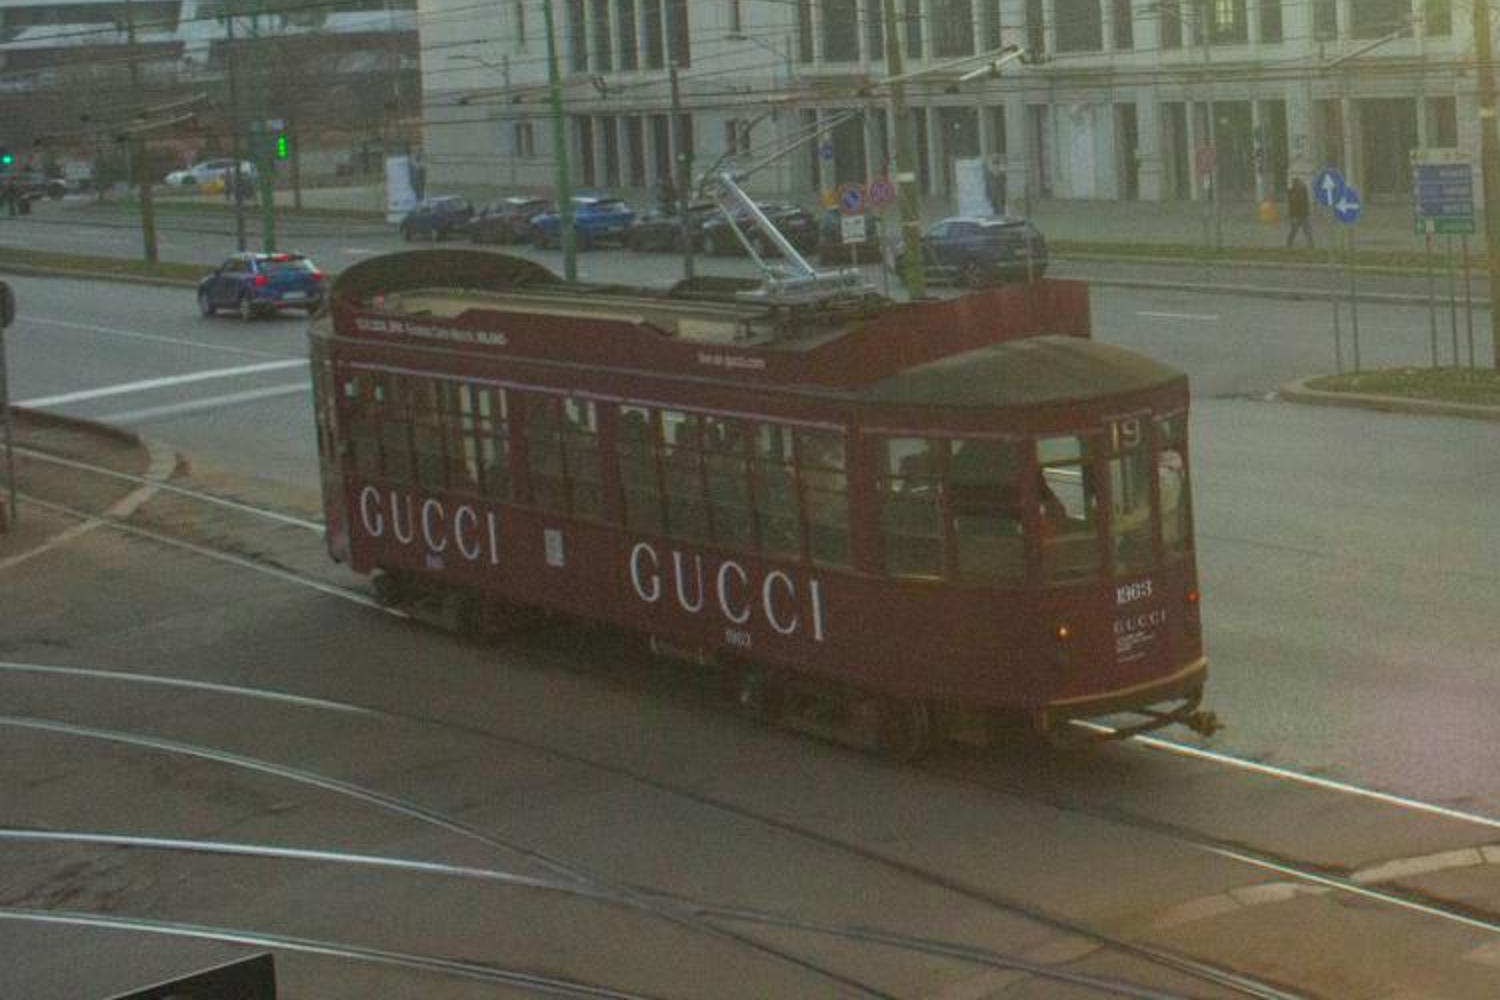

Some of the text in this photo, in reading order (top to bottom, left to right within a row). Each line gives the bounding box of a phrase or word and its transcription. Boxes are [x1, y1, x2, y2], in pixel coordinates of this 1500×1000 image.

[1112, 419, 1140, 452] 19
[360, 485, 499, 565] GUCCI
[630, 542, 824, 641] GUCCI
